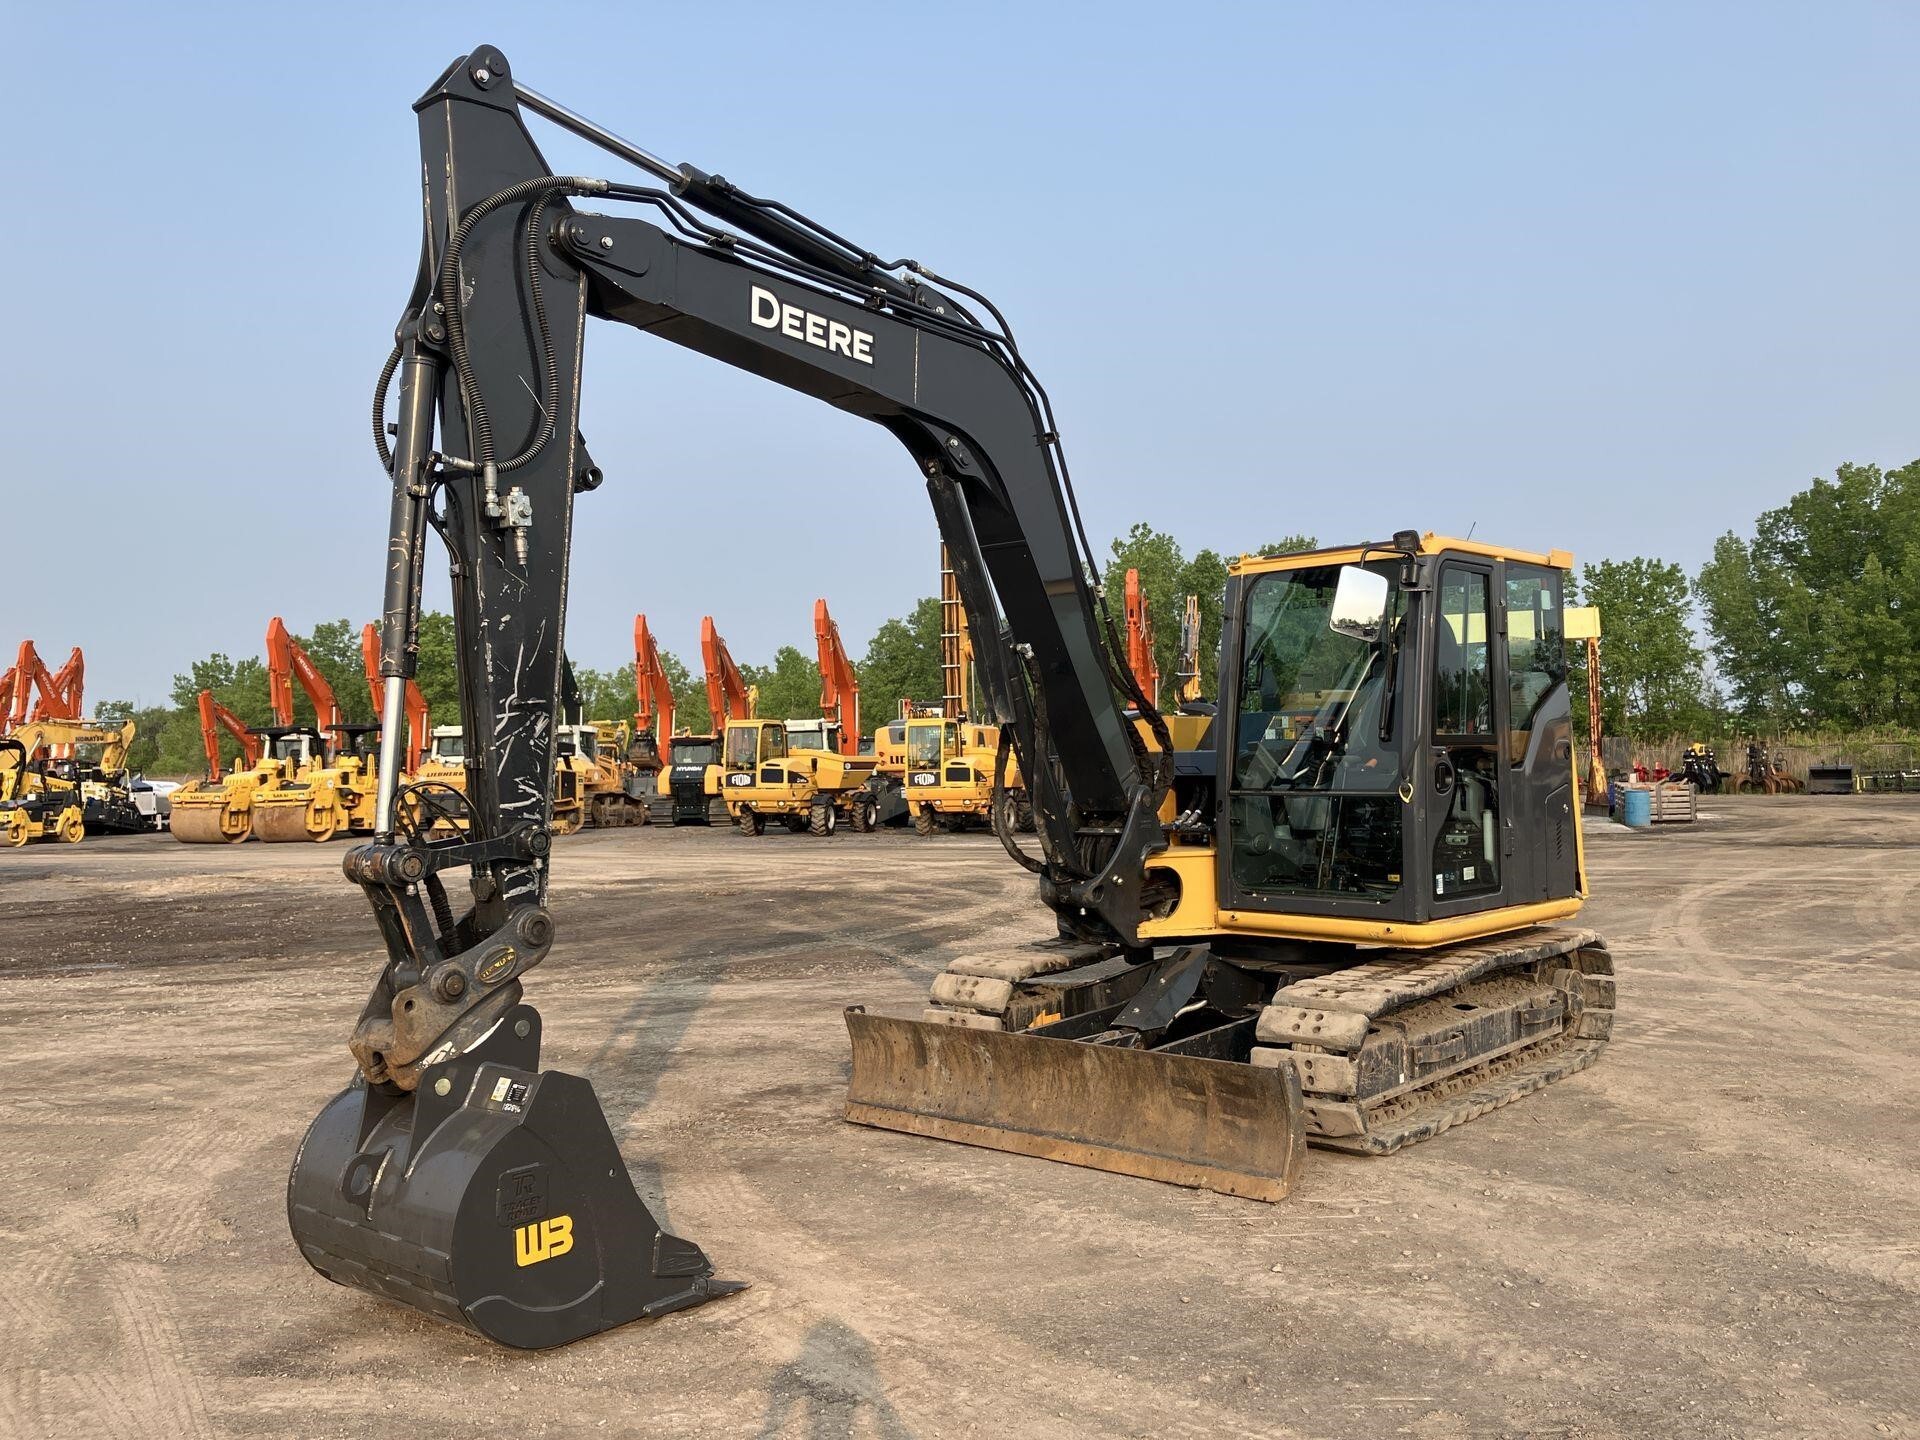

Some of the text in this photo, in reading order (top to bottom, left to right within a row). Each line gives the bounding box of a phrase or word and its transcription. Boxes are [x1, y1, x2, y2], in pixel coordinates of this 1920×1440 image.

[751, 285, 874, 365] DEERE
[731, 773, 751, 786] FIORI
[914, 773, 935, 786] FIORI
[515, 1215, 574, 1267] WB
